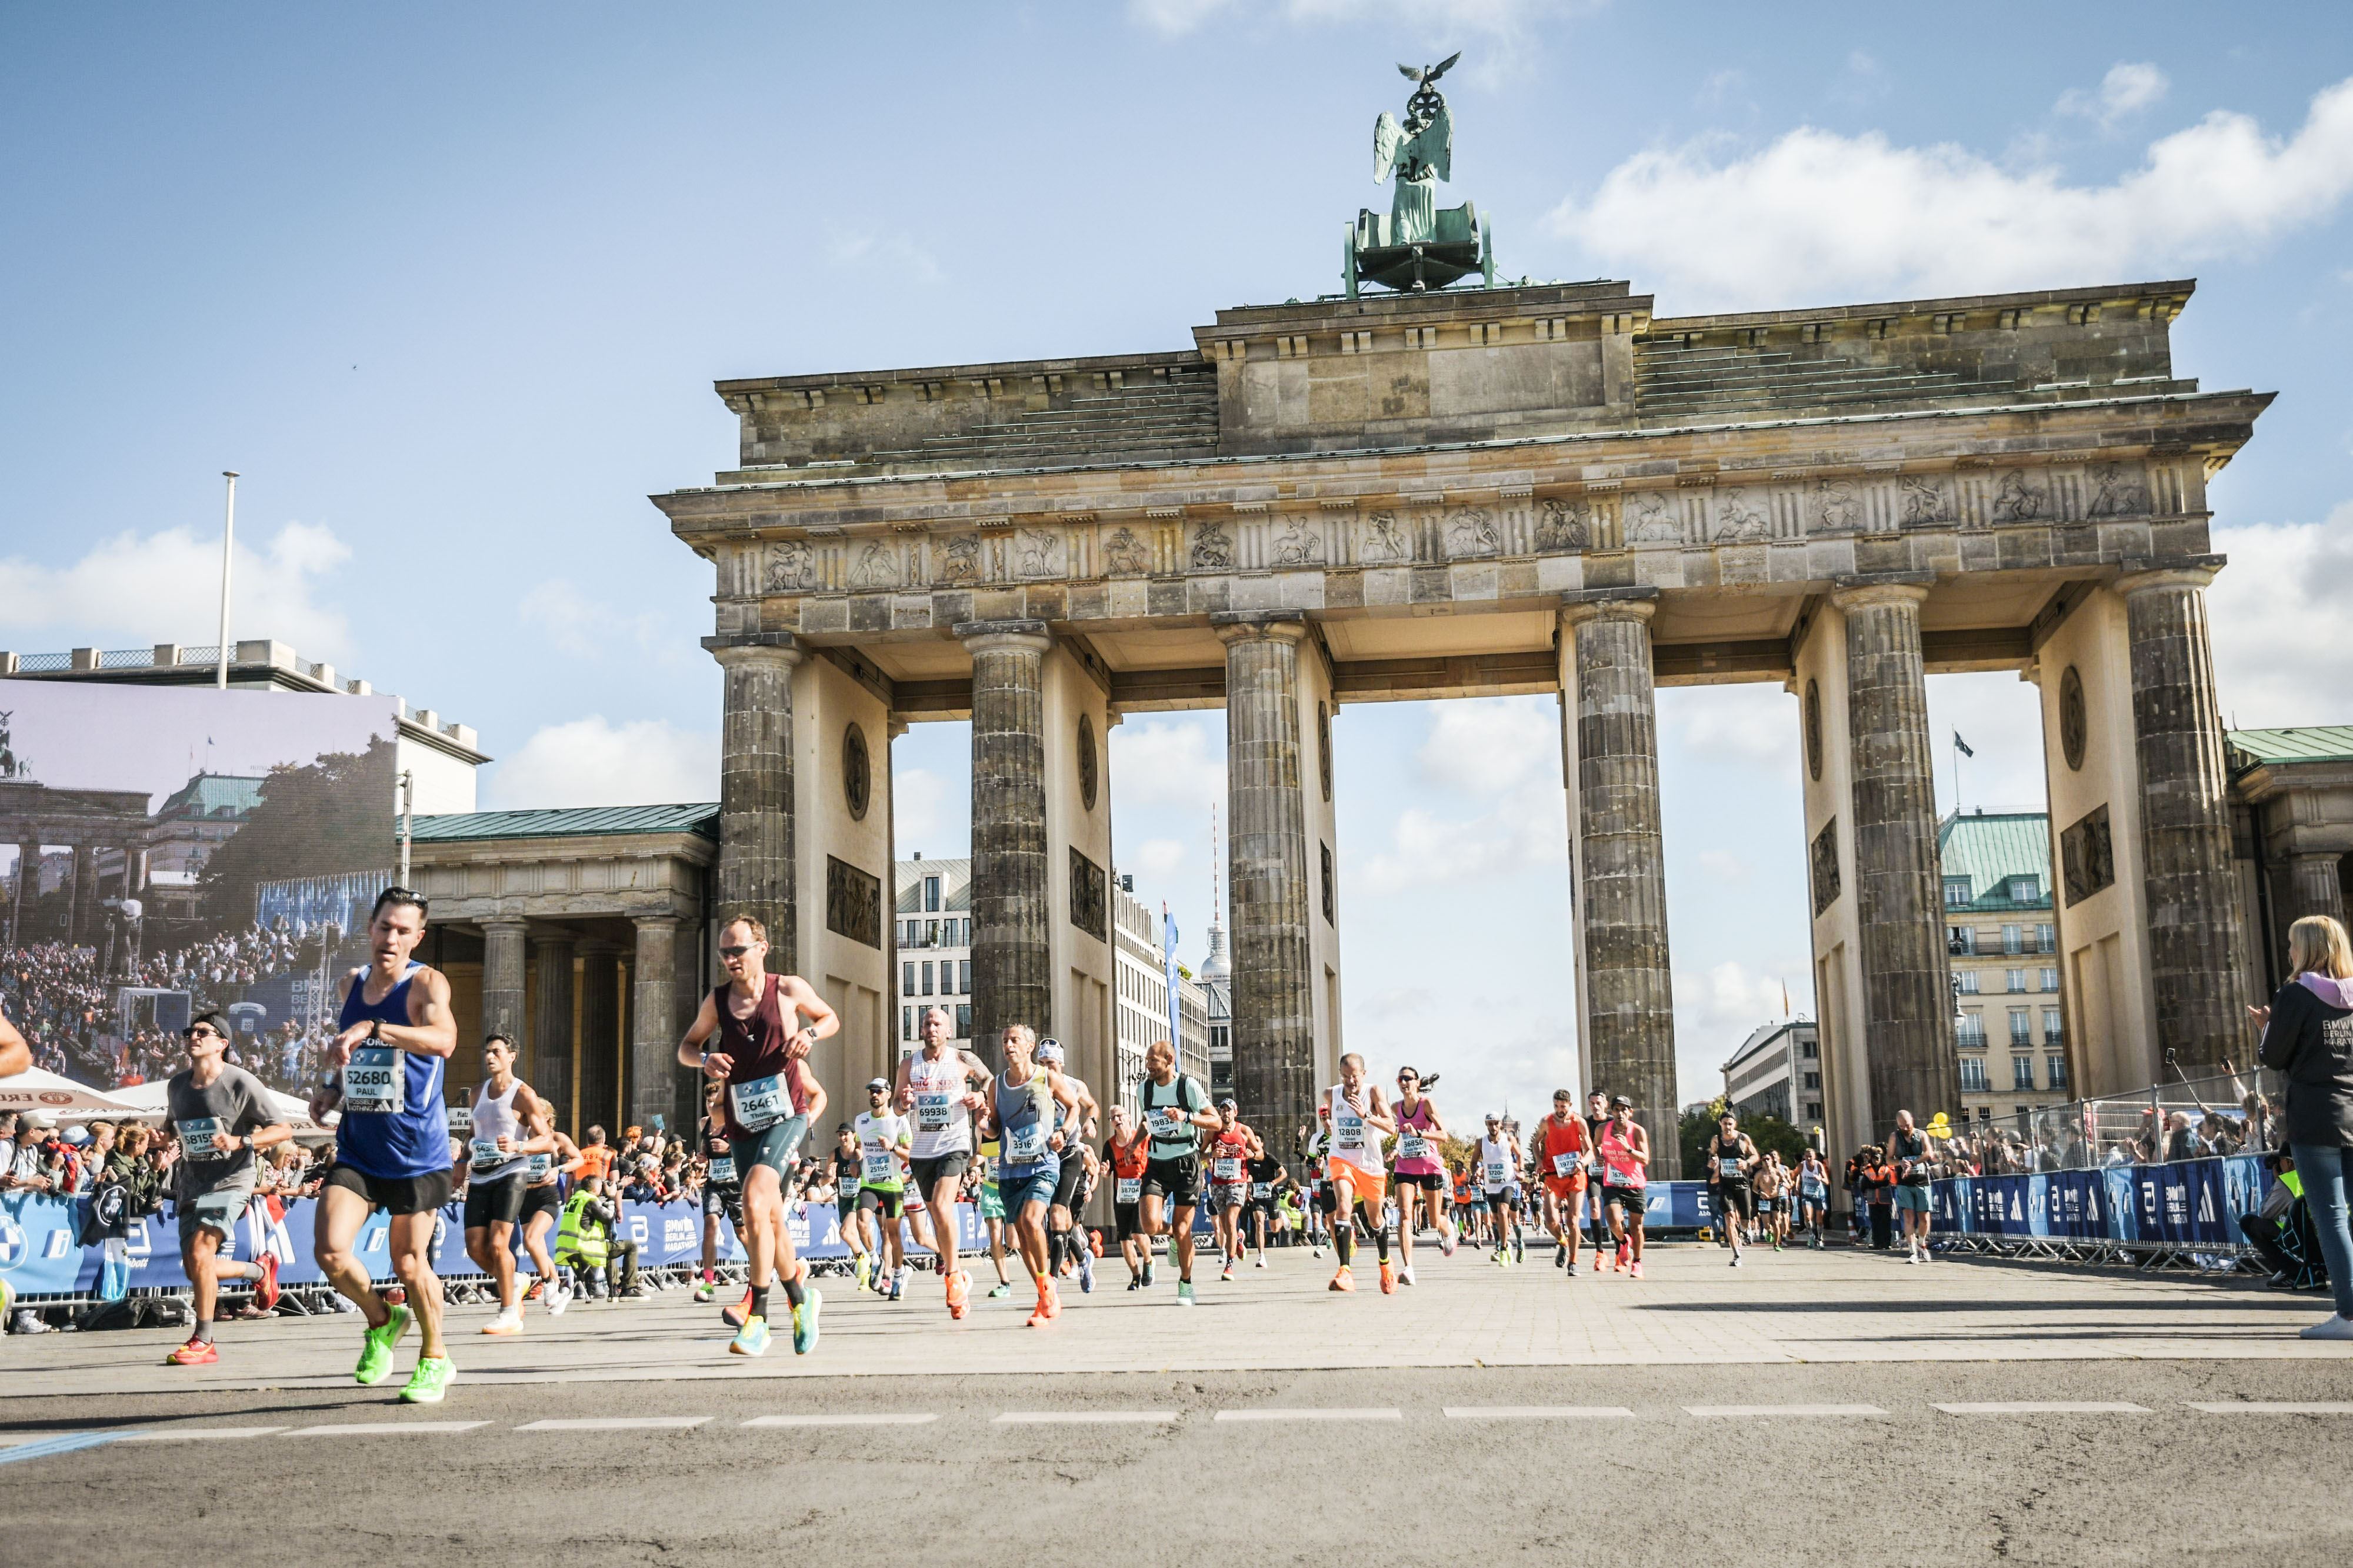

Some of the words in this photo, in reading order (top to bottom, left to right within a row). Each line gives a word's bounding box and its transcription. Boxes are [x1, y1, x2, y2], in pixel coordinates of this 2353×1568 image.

[2322, 1020, 2349, 1030] BMW
[360, 1037, 394, 1046] FORC
[2324, 1037, 2353, 1046] MARAT
[348, 1071, 391, 1085] 52680
[742, 1095, 778, 1113] 26461
[919, 1107, 948, 1116] 69938
[1014, 1137, 1038, 1149] 33160
[1404, 1139, 1424, 1147] 36850
[870, 1165, 888, 1173] 25195
[2165, 1186, 2178, 1201] BMW
[665, 1219, 684, 1233] BMW
[665, 1232, 685, 1242] BERLIN
[126, 1257, 149, 1268] bbott
